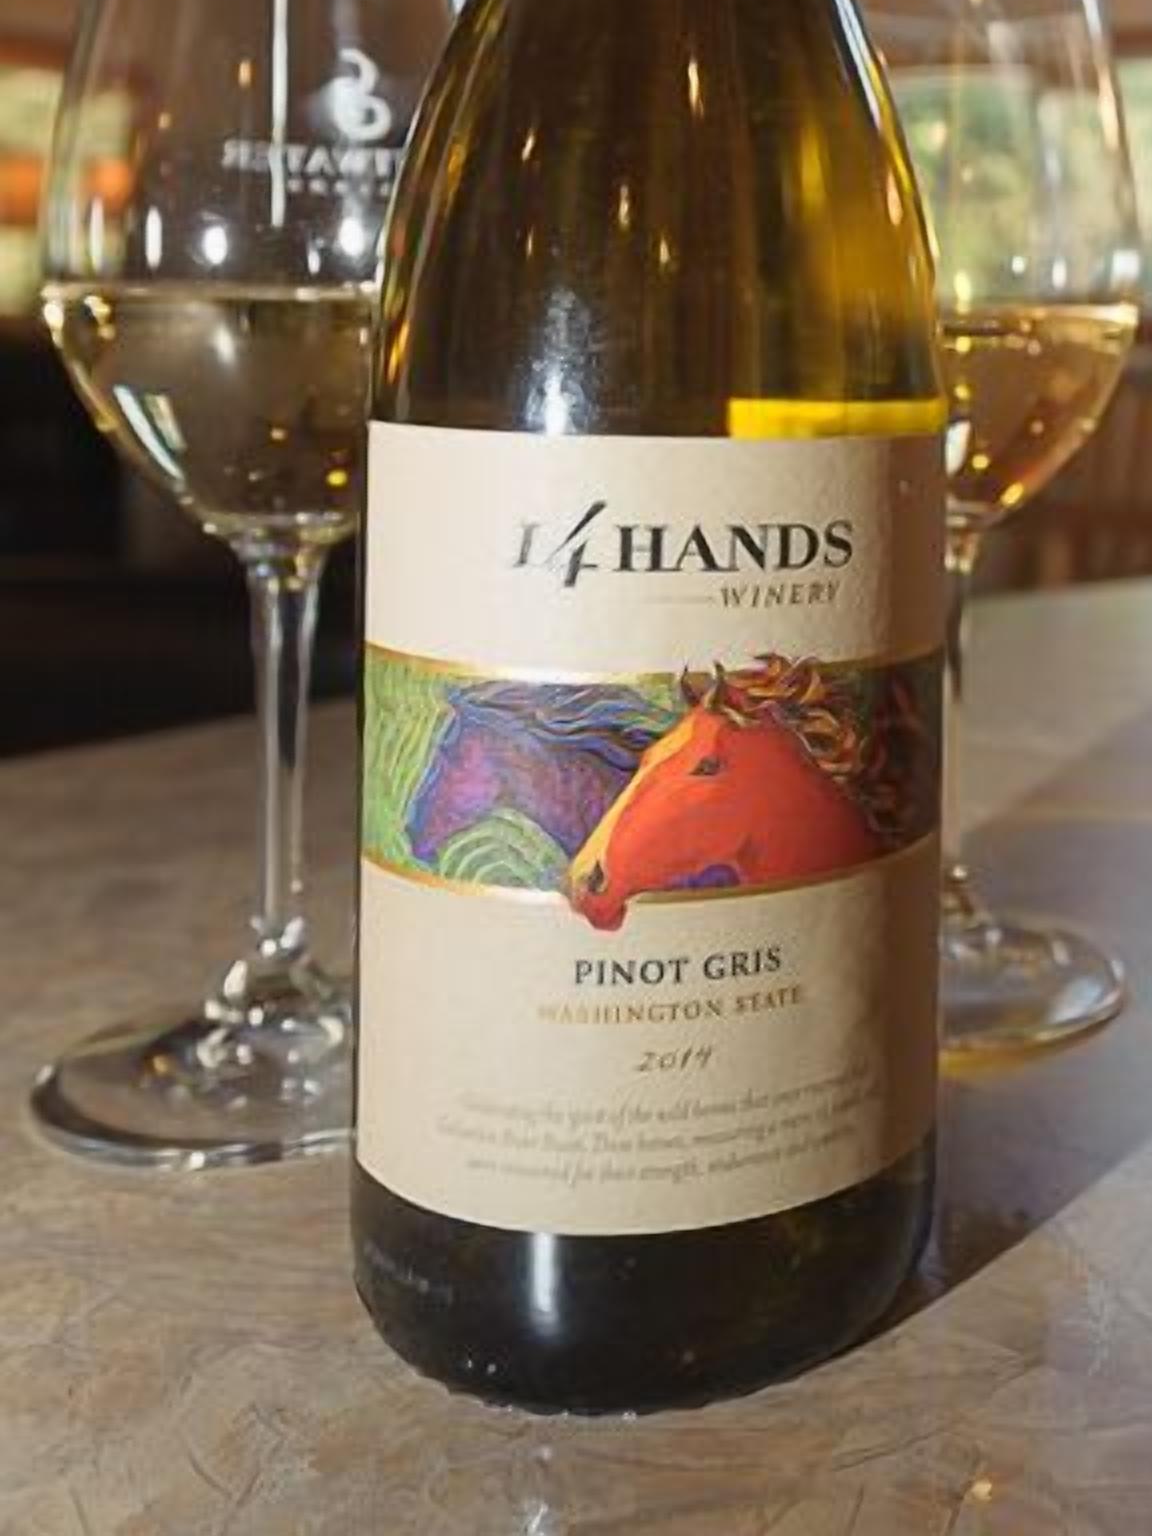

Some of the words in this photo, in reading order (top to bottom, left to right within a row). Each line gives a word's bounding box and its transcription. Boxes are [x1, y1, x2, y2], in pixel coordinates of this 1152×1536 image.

[510, 500, 608, 588] 14
[613, 519, 854, 574] HANDS
[720, 579, 841, 607] WINERY
[573, 956, 690, 986] PINOT
[702, 945, 783, 982] GRIS
[536, 998, 723, 1025] WASHINGTON
[734, 984, 805, 1015] STATE
[635, 1044, 715, 1074] 2014
